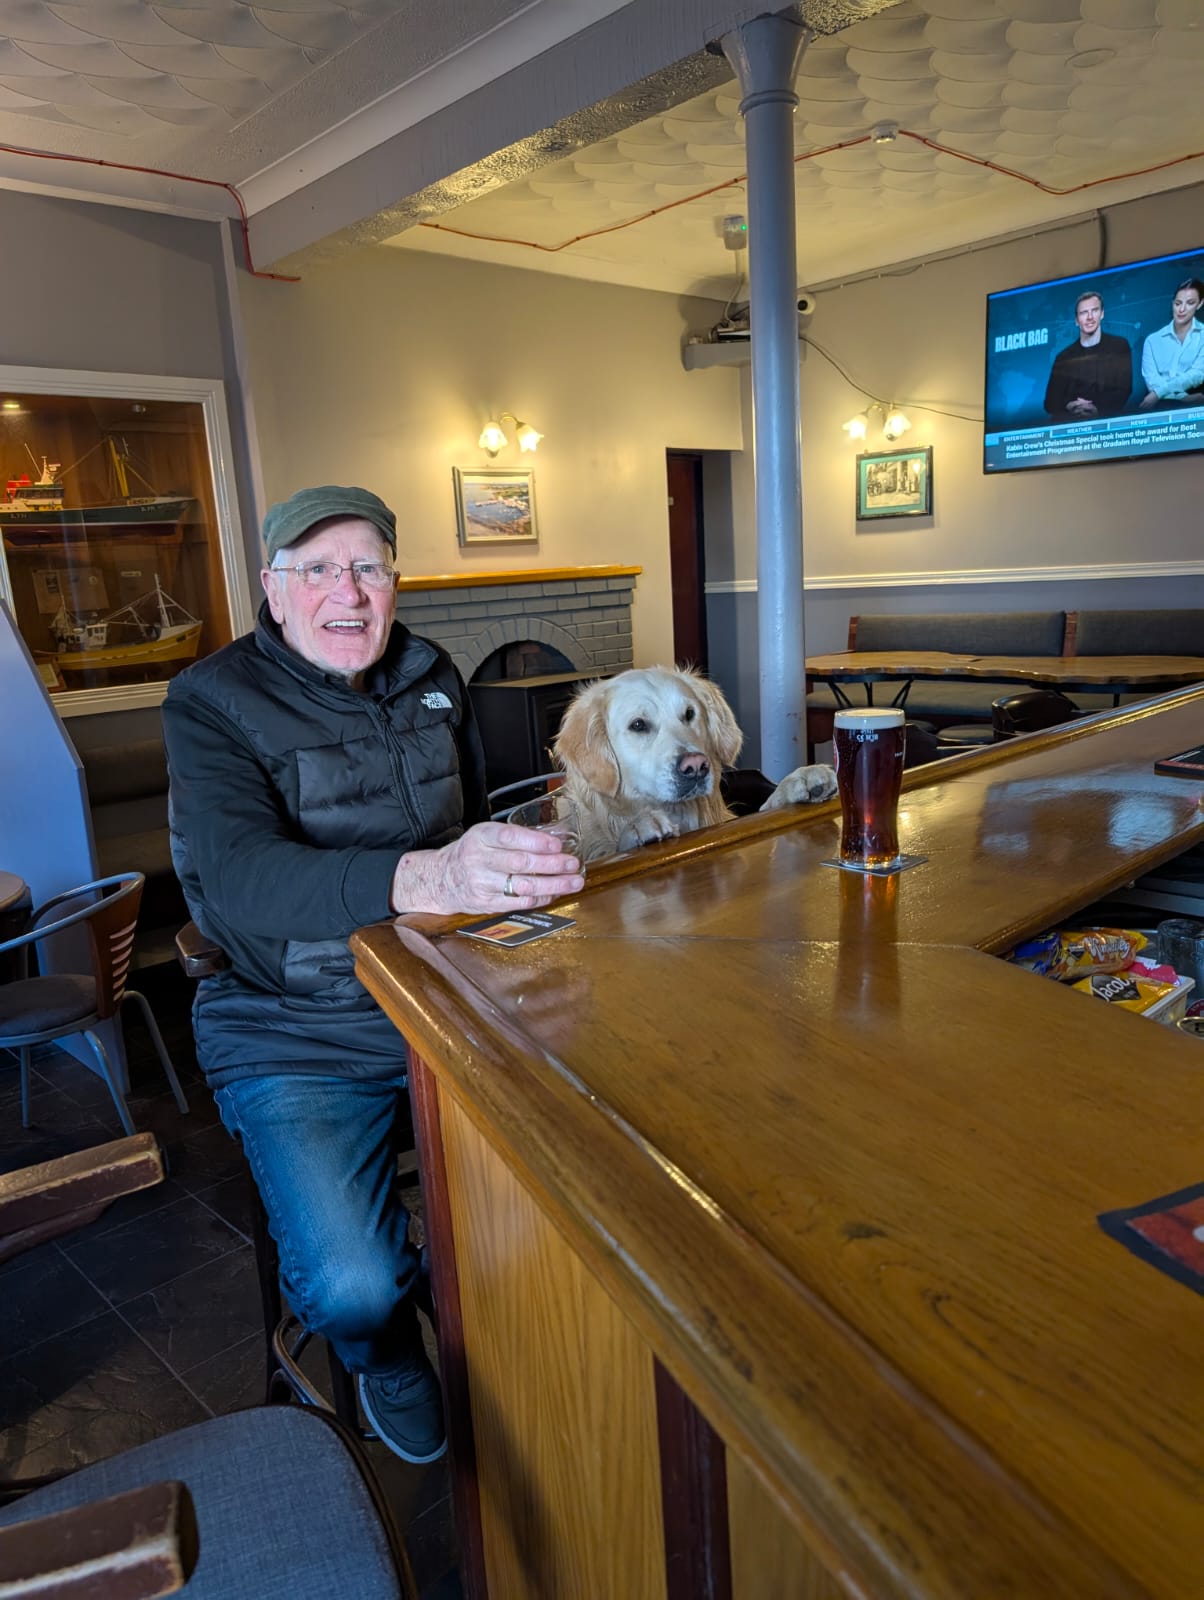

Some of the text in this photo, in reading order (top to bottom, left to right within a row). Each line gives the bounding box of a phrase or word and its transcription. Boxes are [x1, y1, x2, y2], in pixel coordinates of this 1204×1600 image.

[995, 328, 1048, 352] BLACK BAG
[1003, 432, 1044, 442] ENTERTAINMENT
[1006, 423, 1197, 452] Kabin Crew's Christmas Special took home the award for Best
[1066, 426, 1092, 434] WEATHER
[1006, 448, 1046, 459] Entertainment
[1047, 445, 1083, 455] Programme
[1131, 436, 1150, 446] Royal
[1151, 432, 1186, 443] Television
